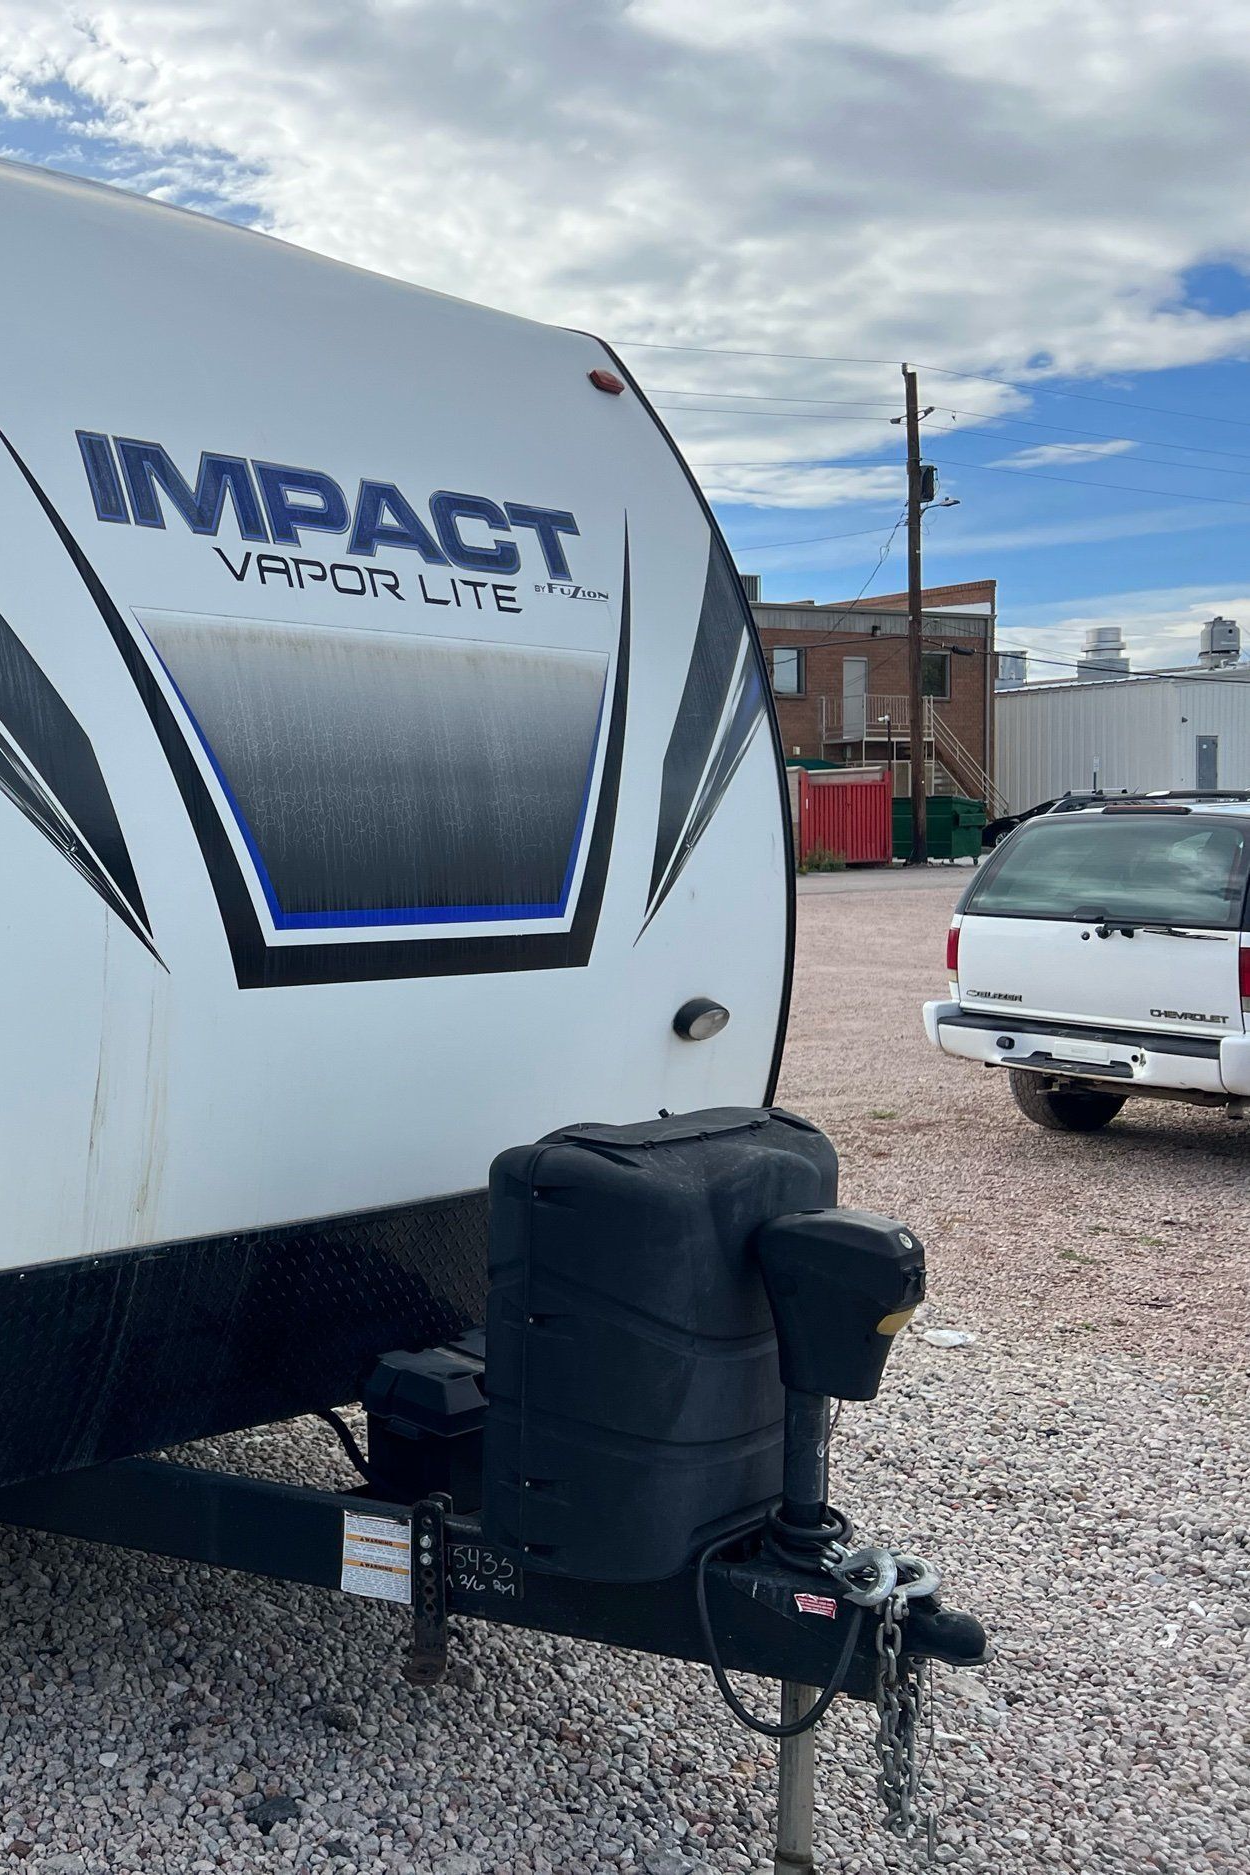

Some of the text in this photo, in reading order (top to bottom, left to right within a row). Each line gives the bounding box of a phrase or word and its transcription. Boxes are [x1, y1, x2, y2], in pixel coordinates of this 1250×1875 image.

[74, 429, 580, 582] IMPACT
[211, 545, 523, 614] VAPOR LITE
[534, 584, 546, 593] BY
[1149, 1008, 1230, 1024] CHEVROLET
[365, 1536, 393, 1547] WARNING
[365, 1562, 393, 1572] WARNING
